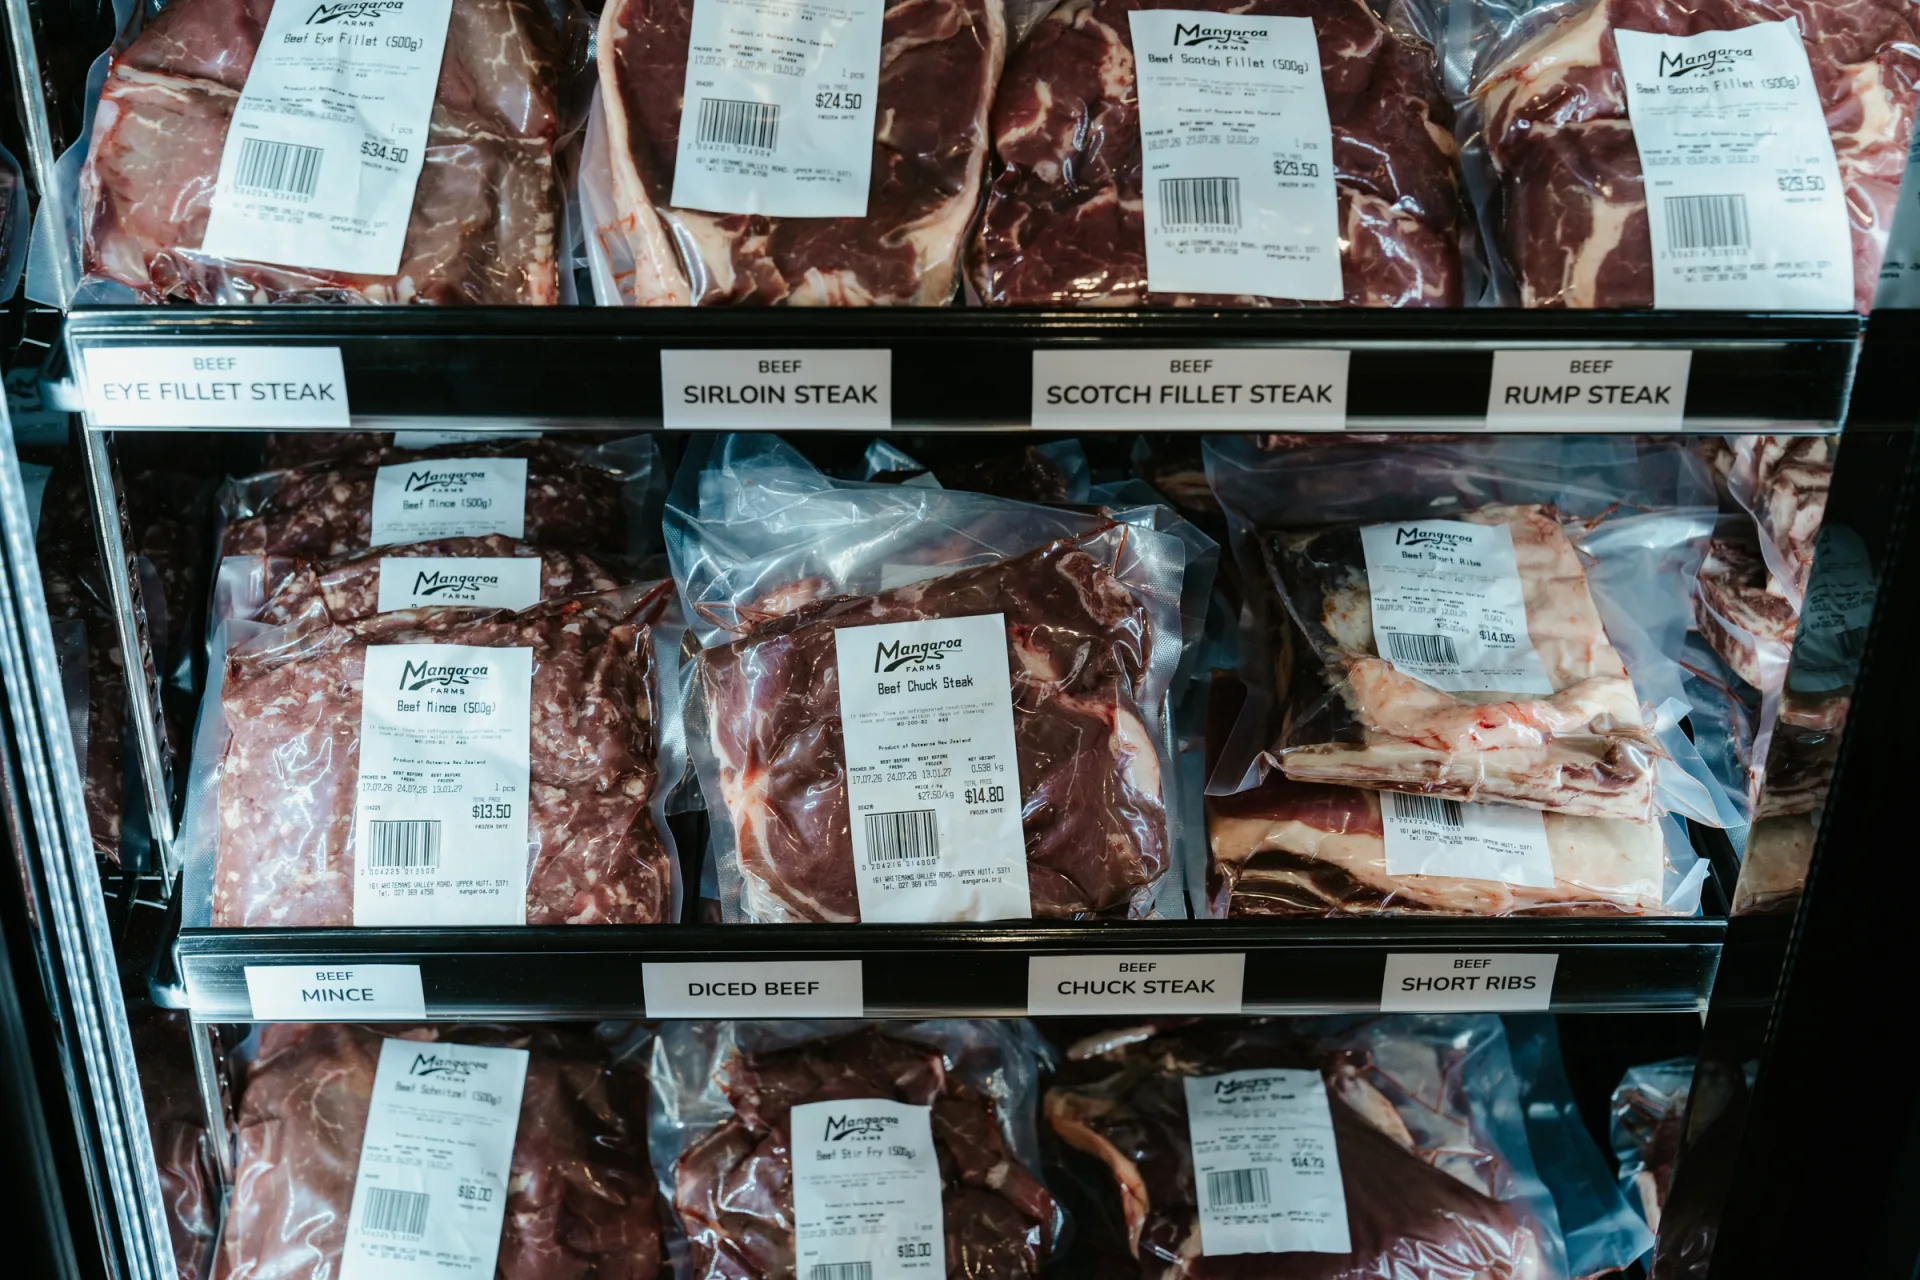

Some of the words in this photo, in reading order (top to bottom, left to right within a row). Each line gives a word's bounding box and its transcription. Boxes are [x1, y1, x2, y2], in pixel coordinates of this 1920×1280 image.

[306, 0, 403, 24] Mangaroa
[284, 33, 308, 43] Beef
[315, 33, 333, 45] Eye
[339, 32, 377, 46] Fillet
[386, 36, 423, 52] (500g)
[1174, 24, 1267, 46] Mangaroa
[1148, 54, 1172, 63] Beef
[1181, 54, 1220, 66] Scotch
[1226, 56, 1264, 68] Fillet
[1273, 59, 1308, 74] (500g)
[1659, 49, 1753, 77] Mangaroa
[1636, 83, 1660, 94] Beef
[1668, 85, 1709, 94] Scotch
[1714, 79, 1753, 90] Fillet
[1761, 76, 1799, 89] (500g)
[816, 93, 861, 109] $24.50
[361, 140, 408, 163] $34.50
[1274, 160, 1318, 177] $29.50
[1777, 176, 1824, 191] $29.50
[193, 357, 236, 370] BEEF
[759, 360, 801, 373] BEEF
[1170, 360, 1212, 373] BEEF
[1570, 360, 1613, 373] BEEF
[104, 383, 151, 400] EYE
[160, 383, 242, 400] FILLET
[251, 383, 335, 400] STEAK
[684, 385, 784, 404] SIRLOIN
[795, 385, 877, 404] STEAK
[1047, 386, 1151, 404] SCOTCH
[1160, 385, 1242, 404] FILLET
[1250, 385, 1332, 403] STEAK
[1505, 386, 1580, 404] RUMP
[1588, 386, 1671, 404] STEAK
[405, 471, 485, 492] Mangaroa
[403, 500, 423, 510] Beef
[430, 499, 456, 508] Mince
[462, 498, 492, 509] (500g)
[1396, 527, 1472, 545] Mangaroa
[1402, 551, 1422, 559] Beef
[1428, 552, 1454, 564] Short
[1460, 558, 1481, 567] Ribs
[413, 571, 498, 595] Mangaroa
[1479, 630, 1515, 643] $14.05
[875, 639, 962, 673] Mangaroa
[400, 660, 488, 690] Mangaroa
[906, 664, 941, 672] FARMS
[878, 681, 900, 695] Beef
[908, 678, 937, 692] Chuck
[943, 675, 973, 688] Steak
[398, 700, 420, 711] Beef
[427, 701, 456, 713] Mince
[464, 702, 495, 715] (500g)
[853, 774, 882, 784] 17.07.26
[887, 771, 917, 782] 24.07.26
[922, 768, 951, 779] 13.01.27
[971, 763, 991, 773] 0.538
[995, 763, 1003, 771] kg
[363, 783, 392, 791] 17.07.26
[397, 784, 427, 793] 24.07.26
[433, 785, 462, 793] 13.01.27
[918, 790, 954, 800] $27.50/kg
[965, 786, 1004, 804] $14.80
[473, 804, 511, 818] $13.50
[885, 874, 914, 883] WHITEMANS
[958, 869, 975, 877] UPPER
[1119, 963, 1156, 972] BEEF
[1454, 959, 1491, 968] BEEF
[316, 972, 353, 980] BEEF
[1402, 977, 1480, 991] SHORT
[1486, 976, 1536, 990] RIBS
[302, 989, 374, 1001] MINCE
[689, 983, 756, 996] DICED
[765, 982, 819, 995] BEEF
[1058, 981, 1136, 995] CHUCK
[1143, 980, 1215, 994] STEAK
[396, 1081, 415, 1092] Beef
[421, 1084, 466, 1098] Schnitzel
[824, 1115, 898, 1141] Mangaroa
[817, 1150, 835, 1160] Beef
[841, 1148, 862, 1159] Stir
[867, 1146, 883, 1158] Fry
[458, 1185, 492, 1202] $16.00
[898, 1243, 931, 1258] $16.00
